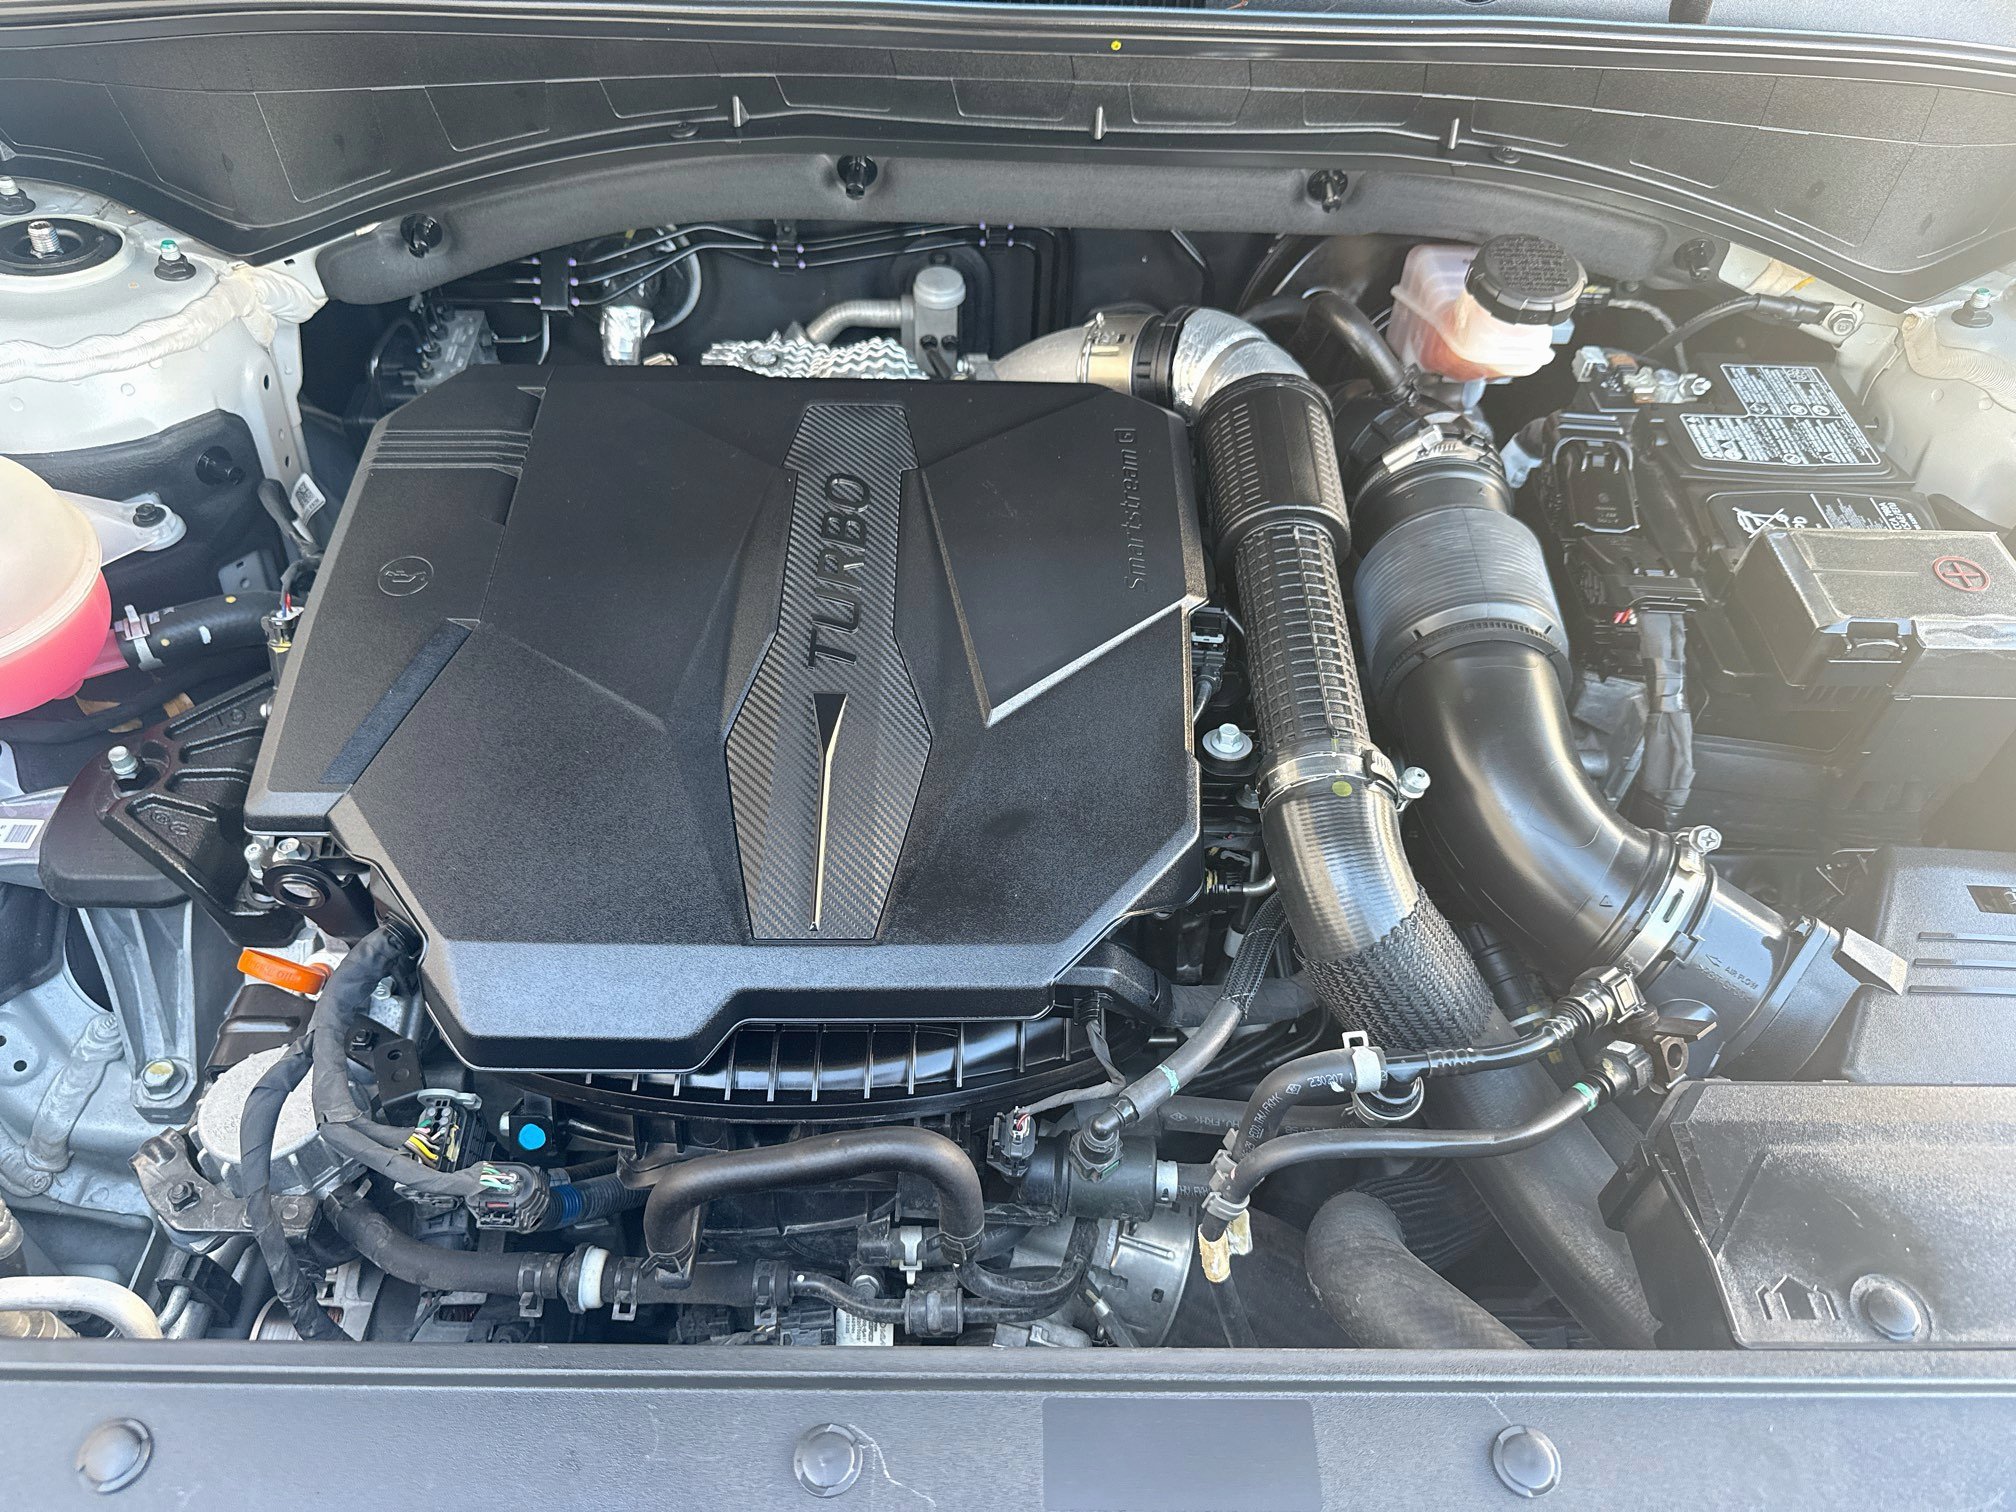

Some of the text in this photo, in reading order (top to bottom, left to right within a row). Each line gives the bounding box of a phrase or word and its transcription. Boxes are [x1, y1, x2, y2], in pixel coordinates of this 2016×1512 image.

[807, 472, 871, 672] TURBO
[1119, 449, 1147, 593] Smartstream
[1307, 1072, 1343, 1088] 230207
